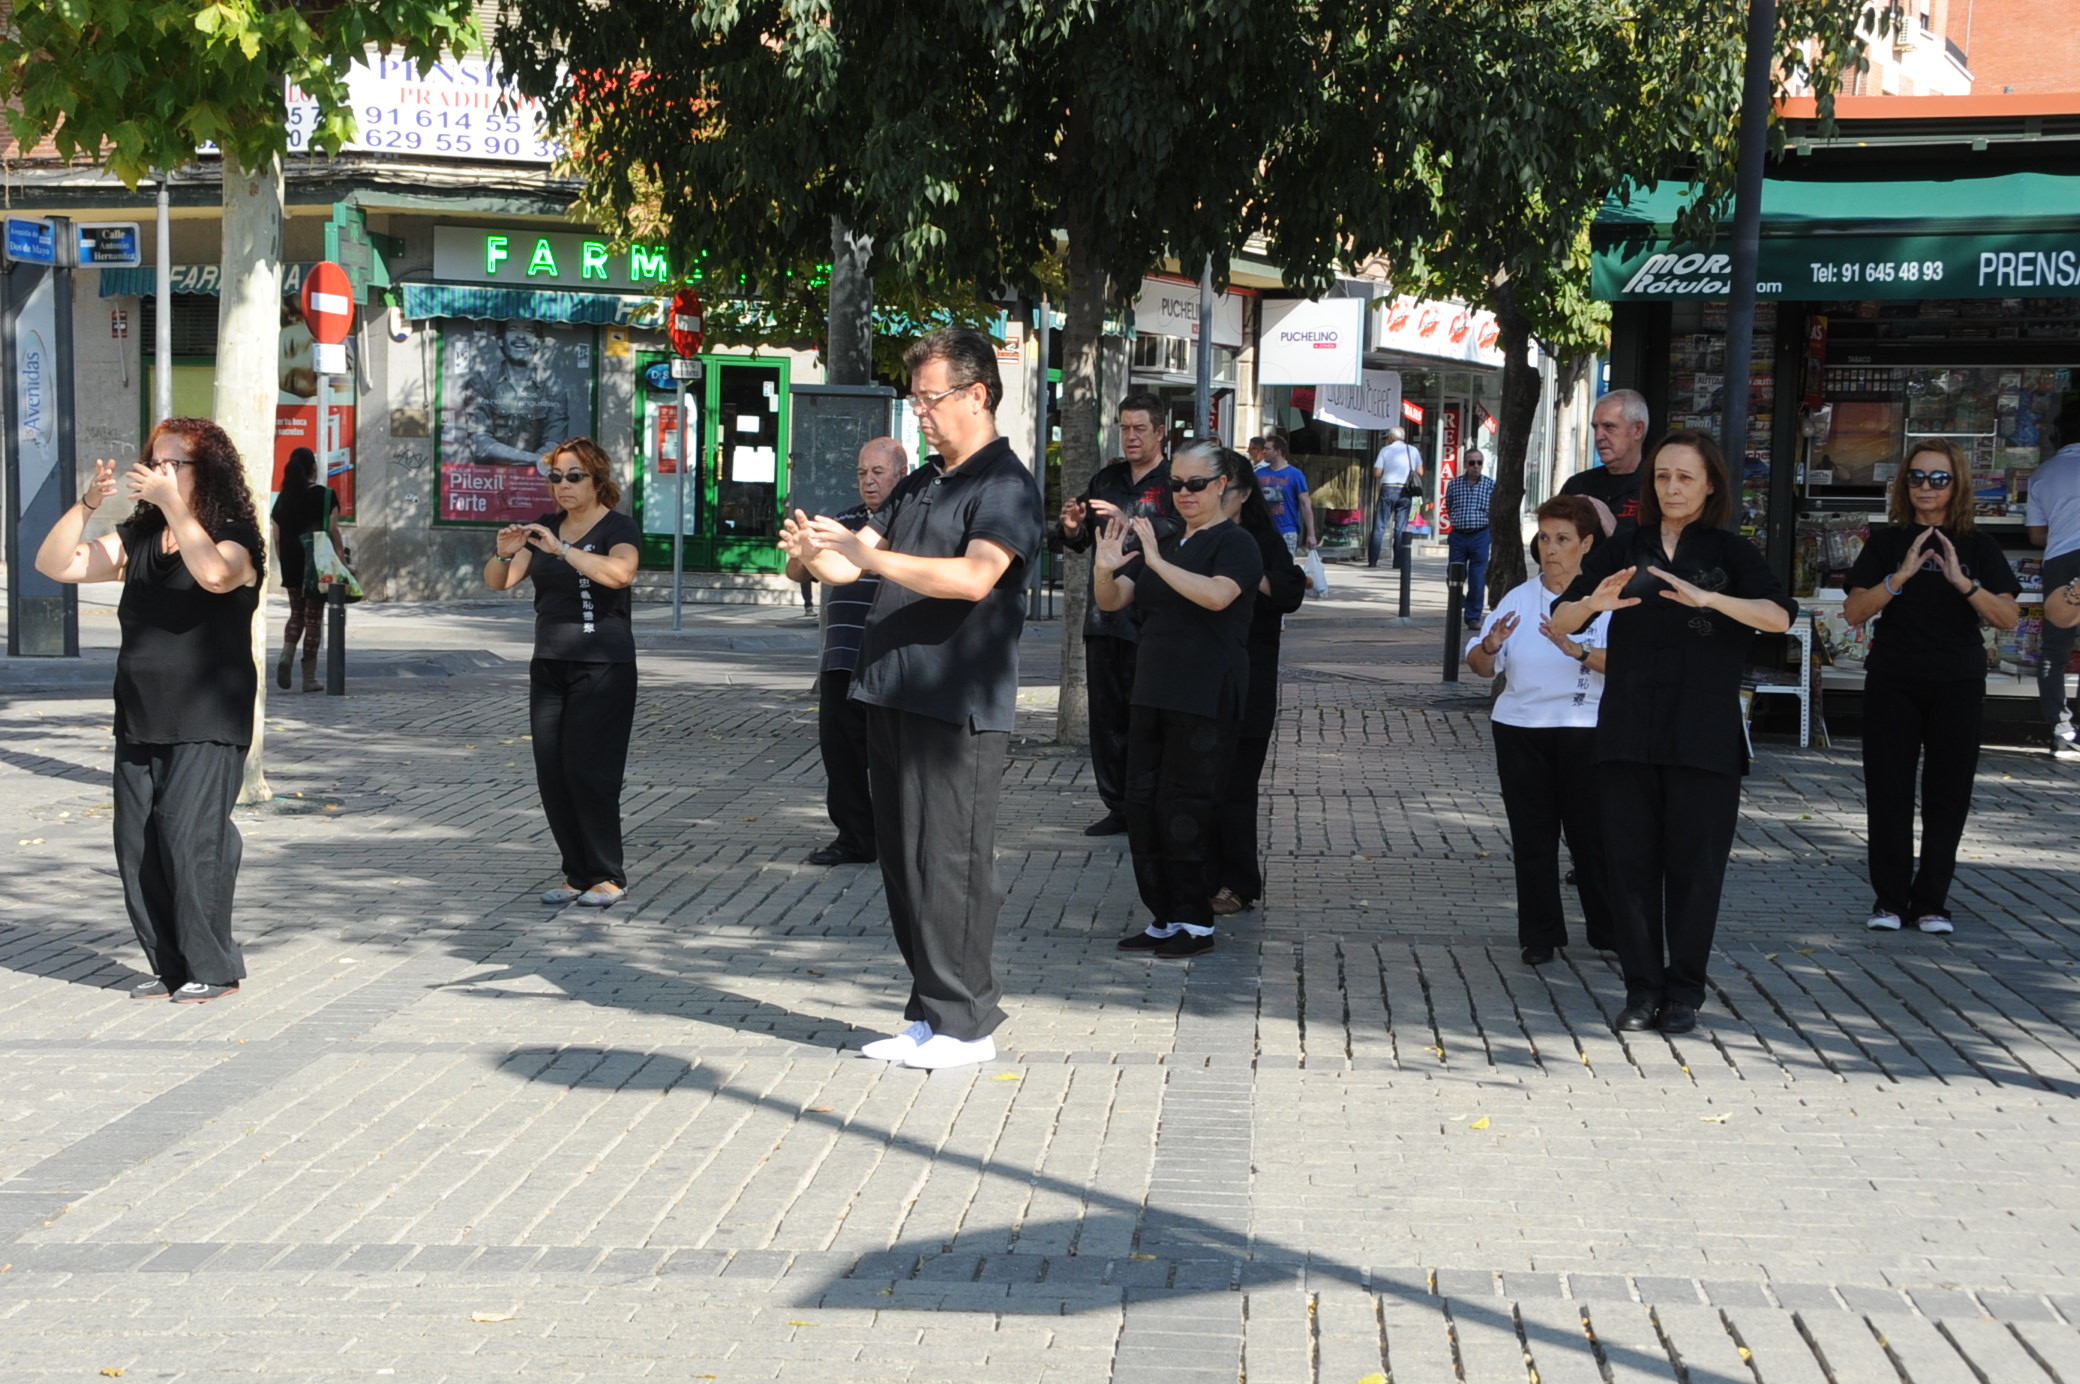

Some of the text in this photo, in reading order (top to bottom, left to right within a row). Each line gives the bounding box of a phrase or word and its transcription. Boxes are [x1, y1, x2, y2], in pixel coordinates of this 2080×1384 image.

[366, 106, 521, 133] 91 614 55
[366, 129, 422, 149] 629
[436, 133, 472, 152] 55
[485, 136, 520, 155] 90
[102, 229, 126, 239] Calle
[10, 240, 50, 257] Dos de Mayo
[100, 240, 130, 249] Antonio
[1628, 253, 1732, 280] MOR
[1810, 260, 1943, 282] Tel: 91 645 48 93
[1978, 250, 2080, 287] PRENS
[1280, 331, 1338, 342] PUCHELINO
[22, 351, 41, 431] Avenidas
[449, 472, 505, 491] Pilexil
[449, 493, 487, 512] Forte
